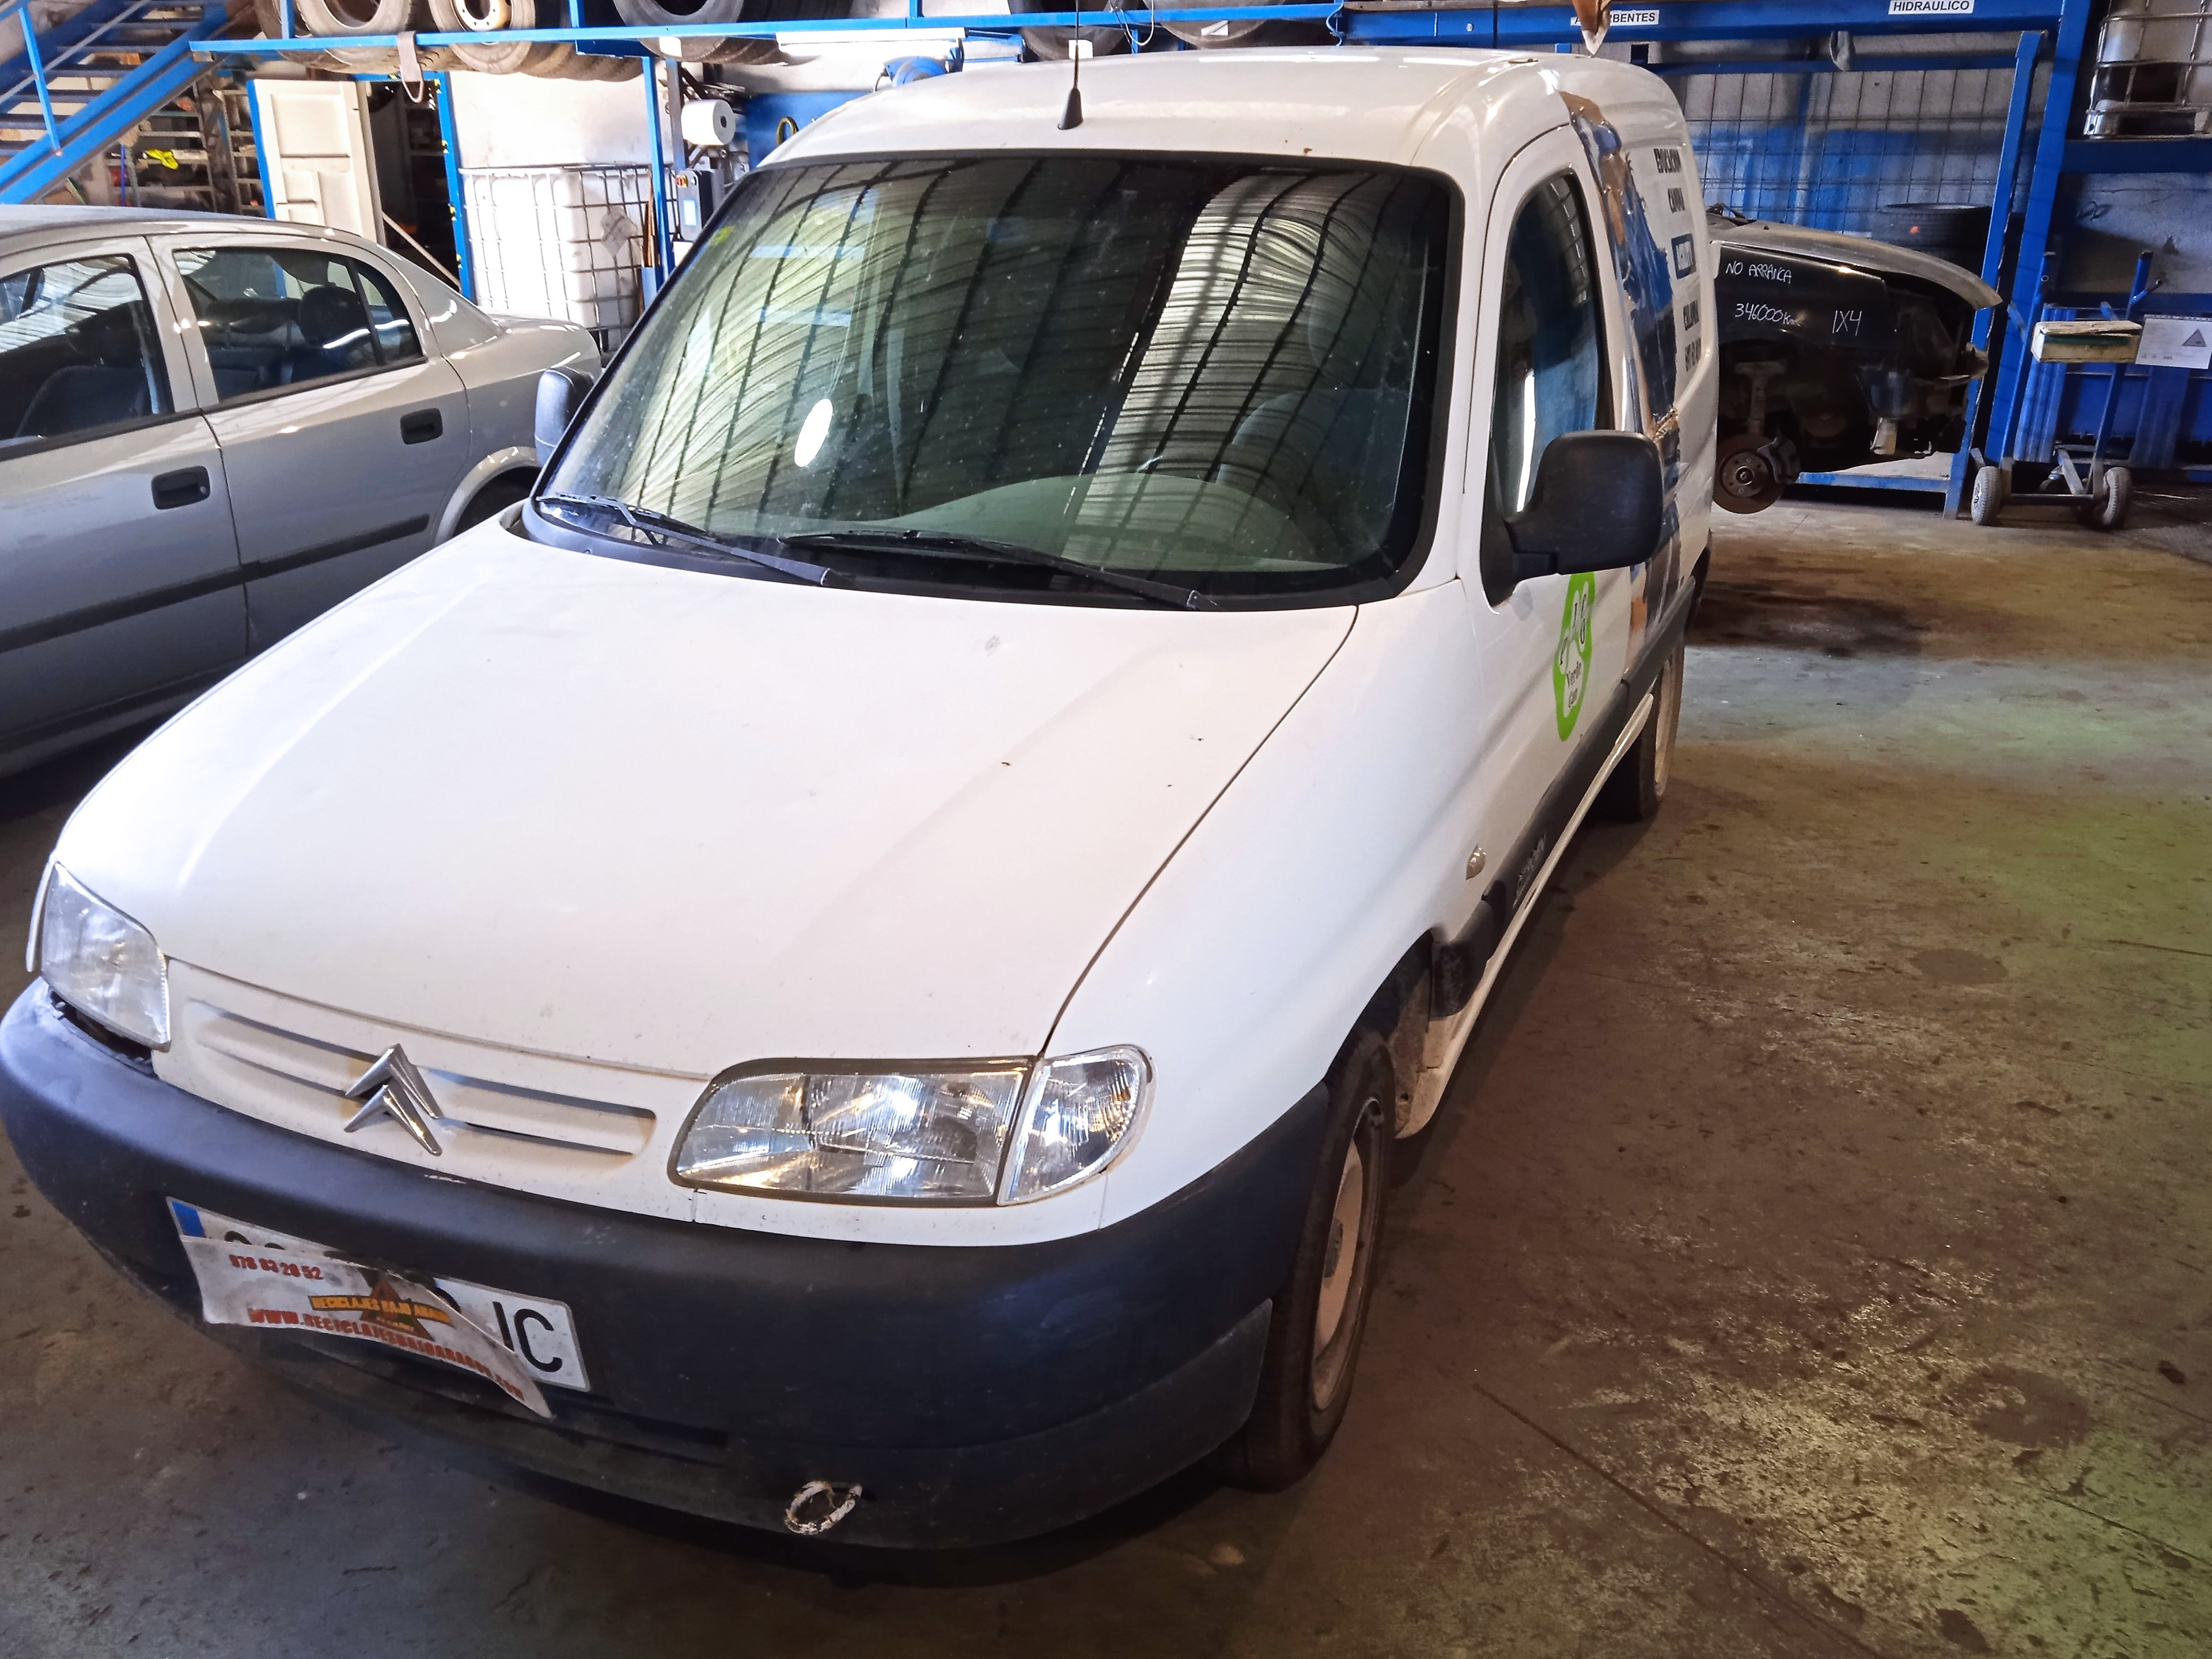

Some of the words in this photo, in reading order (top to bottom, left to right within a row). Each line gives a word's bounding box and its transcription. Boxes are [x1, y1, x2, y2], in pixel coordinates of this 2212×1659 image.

[1893, 0, 1970, 12] HIDRAULICO
[1725, 260, 1744, 275] NO
[1748, 263, 1793, 284] ARRANCA
